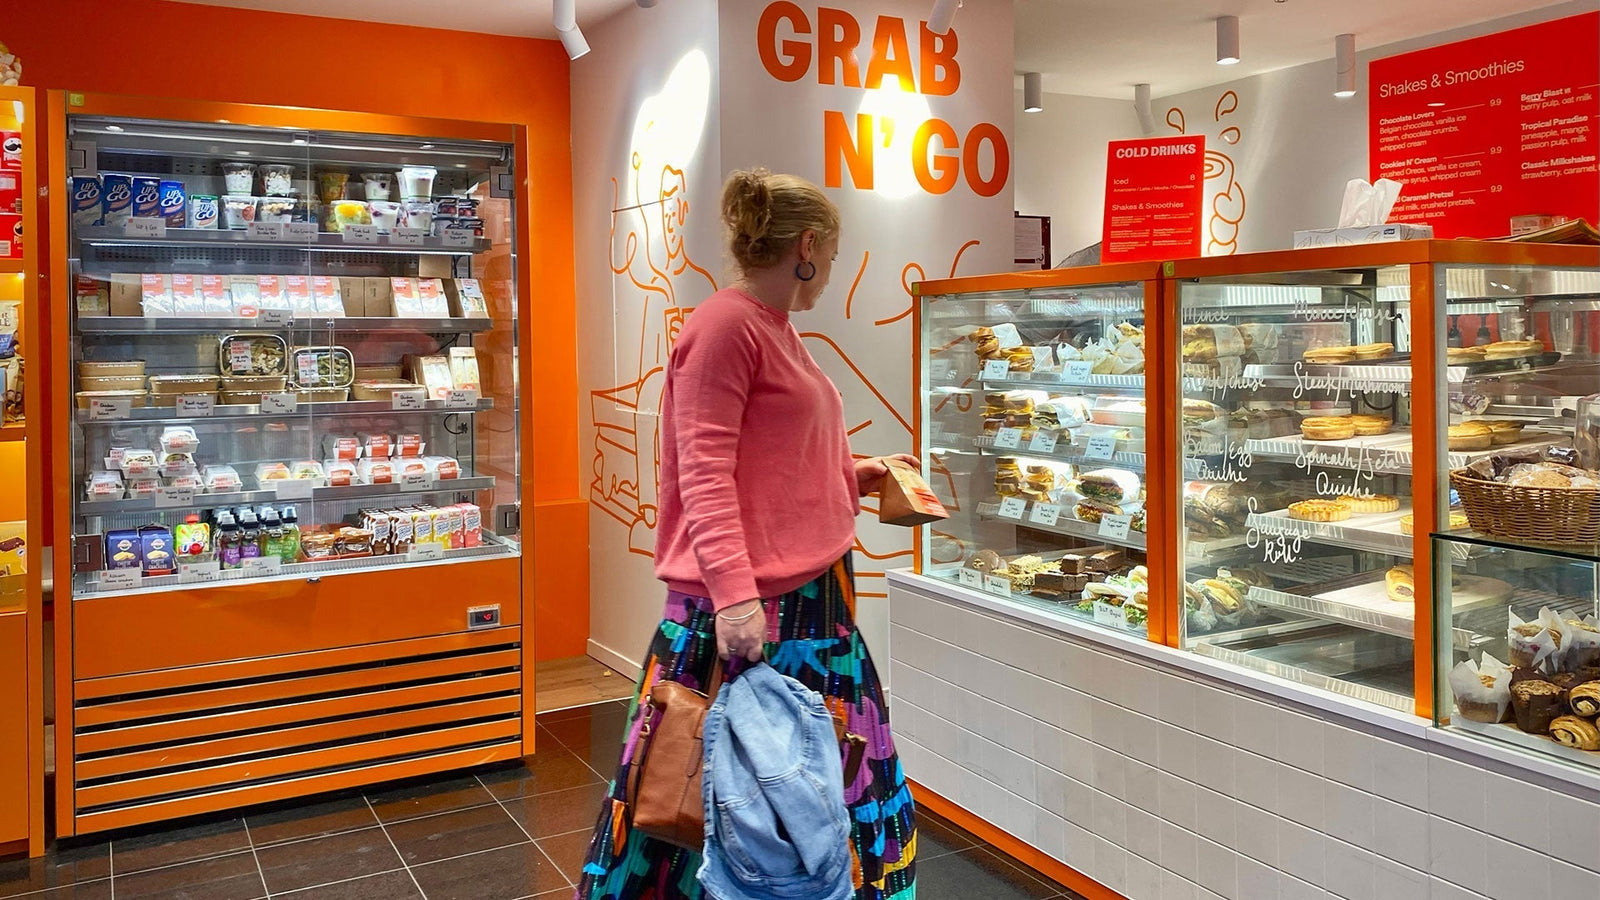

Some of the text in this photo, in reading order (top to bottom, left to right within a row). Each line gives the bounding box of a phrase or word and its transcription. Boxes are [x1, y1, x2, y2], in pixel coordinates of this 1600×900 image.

[757, 0, 961, 97] GRAB
[1379, 60, 1525, 98] Shakes & Smoothies
[1521, 93, 1542, 102] Berry
[1543, 88, 1563, 98] Blast
[1490, 98, 1502, 107] 9.9
[1379, 111, 1435, 126] Chocolate Lovers
[1521, 115, 1589, 131] Tropical Paradise
[1379, 123, 1402, 135] Belgian
[1435, 116, 1456, 126] vanilla
[1401, 130, 1432, 140] chocolate
[1379, 140, 1427, 153] whipped cream
[1521, 141, 1550, 152] passion
[1570, 134, 1587, 144] milk
[912, 117, 1010, 197] GO
[1116, 143, 1196, 159] COLD DRINKS
[1490, 146, 1502, 155] 9.9
[1379, 162, 1406, 171] Cookies
[1414, 156, 1437, 165] Cream
[1427, 164, 1447, 172] vanilla
[1447, 162, 1458, 170] ice
[1521, 155, 1596, 170] Classic Milkshakes
[1430, 172, 1459, 182] whipped
[1459, 169, 1482, 178] cream
[74, 188, 100, 200] GO
[106, 190, 131, 202] GO
[135, 192, 159, 204] GO
[1400, 193, 1429, 203] Caramel
[1429, 190, 1454, 200] Pretzel
[1490, 184, 1503, 193] 9.9
[160, 195, 184, 207] GO
[1111, 203, 1137, 211] Shakes
[1145, 201, 1184, 210] Smoothies
[1420, 200, 1447, 210] crushed
[195, 209, 216, 220] GO
[1399, 212, 1425, 222] caramel
[1316, 471, 1377, 498] Quiche
